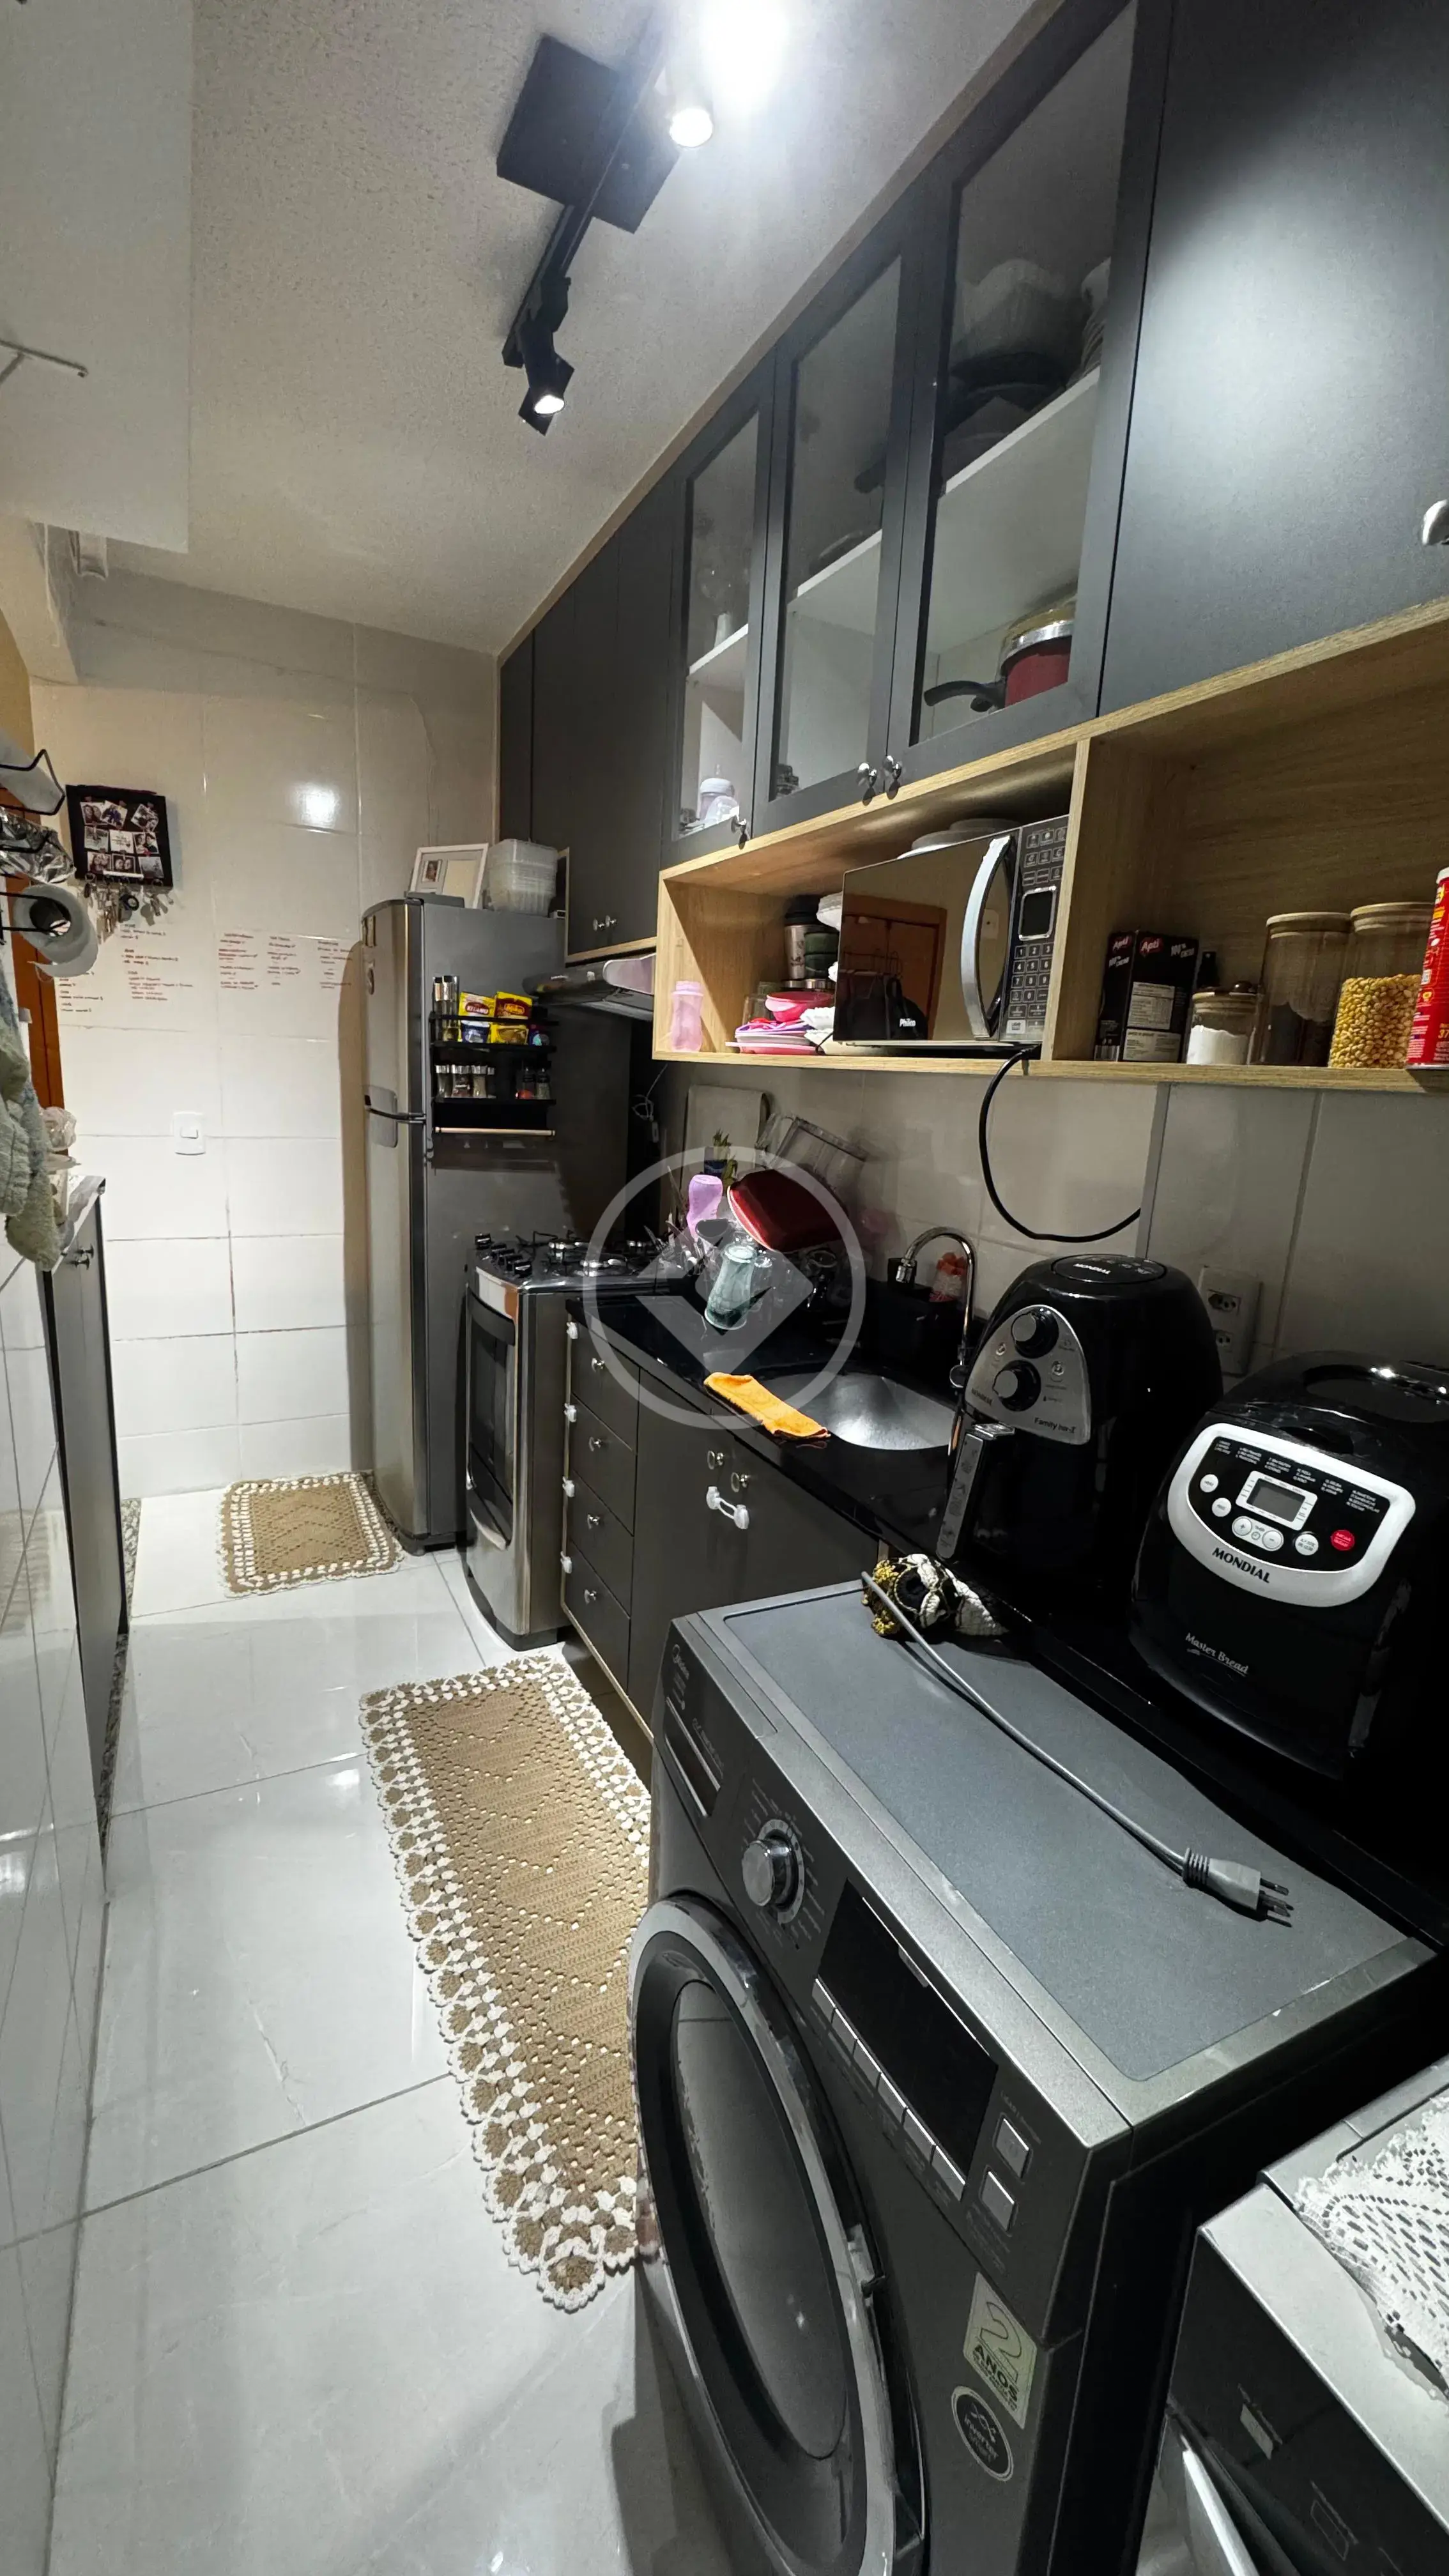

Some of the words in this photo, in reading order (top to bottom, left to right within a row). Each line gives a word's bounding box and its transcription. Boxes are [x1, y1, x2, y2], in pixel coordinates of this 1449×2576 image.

[1046, 945, 1051, 953] 3
[1140, 938, 1160, 953] Apti
[1044, 960, 1048, 969] 6
[899, 1018, 916, 1027] Philco
[1034, 1416, 1058, 1430] Family
[1212, 1547, 1270, 1583] MONDIAL
[1185, 1632, 1216, 1657] Master
[1217, 1651, 1249, 1675] Bread
[979, 2301, 1022, 2384] 2
[974, 2344, 1018, 2402] ANOS
